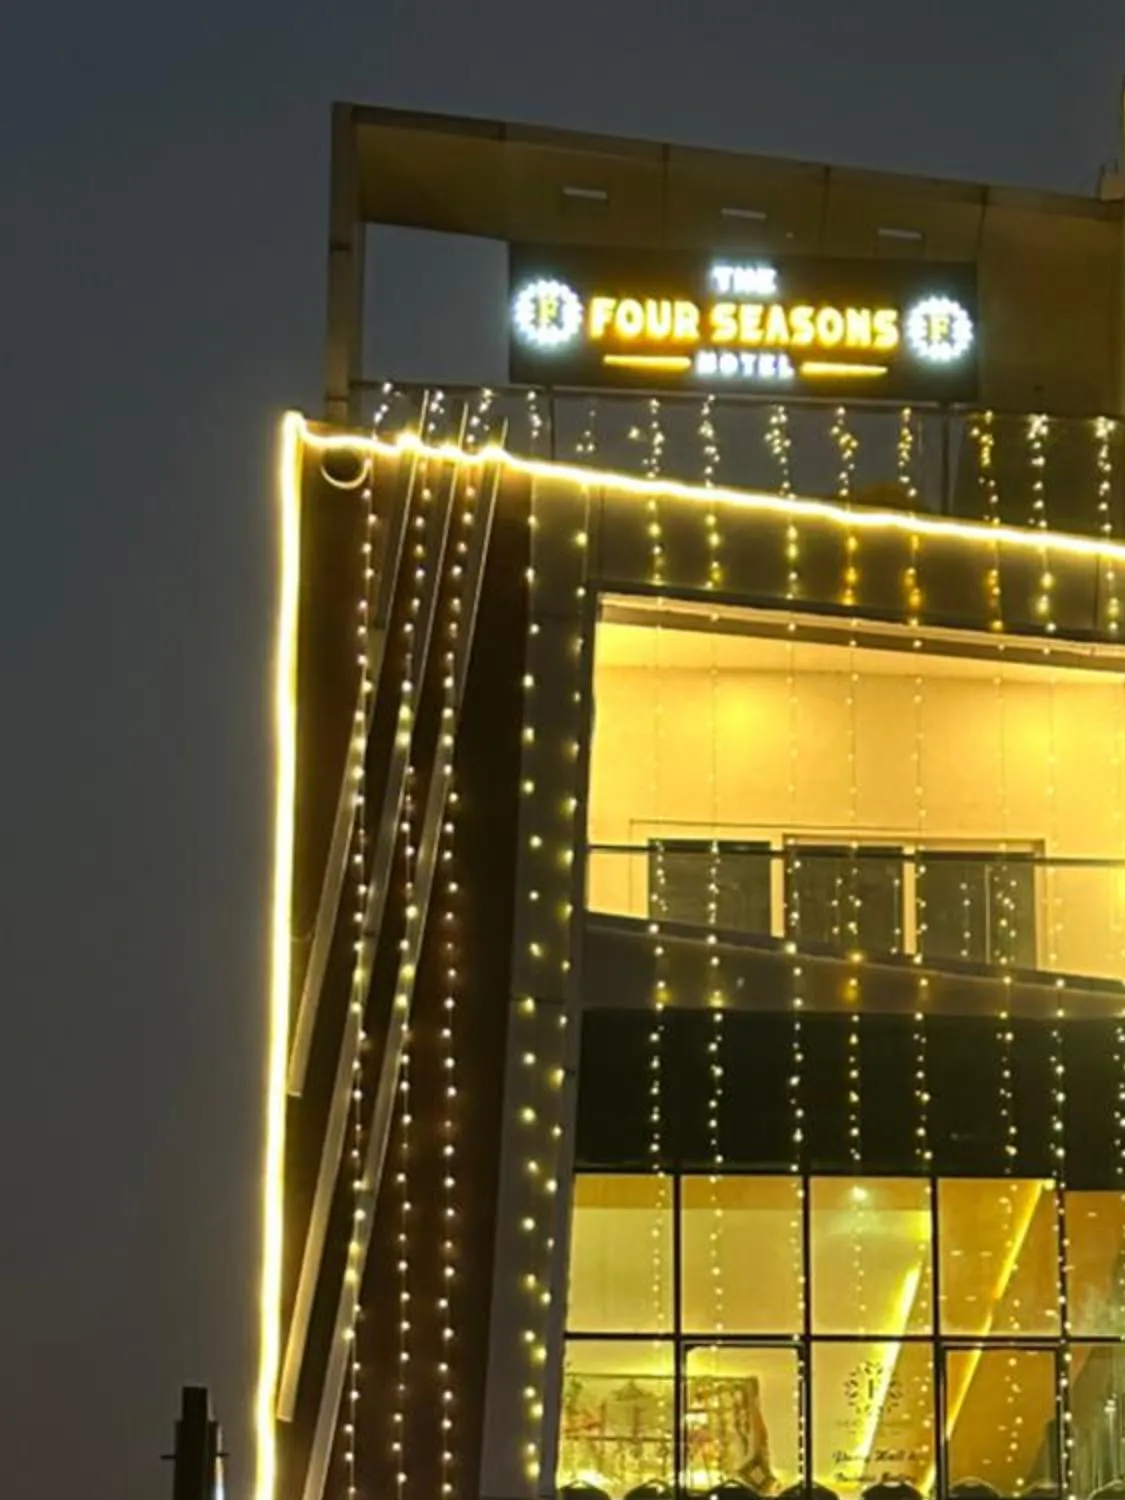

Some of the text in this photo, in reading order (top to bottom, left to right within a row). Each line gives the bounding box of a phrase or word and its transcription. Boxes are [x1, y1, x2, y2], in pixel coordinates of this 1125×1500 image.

[711, 265, 777, 294] THE
[590, 296, 898, 350] FOUR SEASONS
[695, 351, 794, 379] HOTEL
